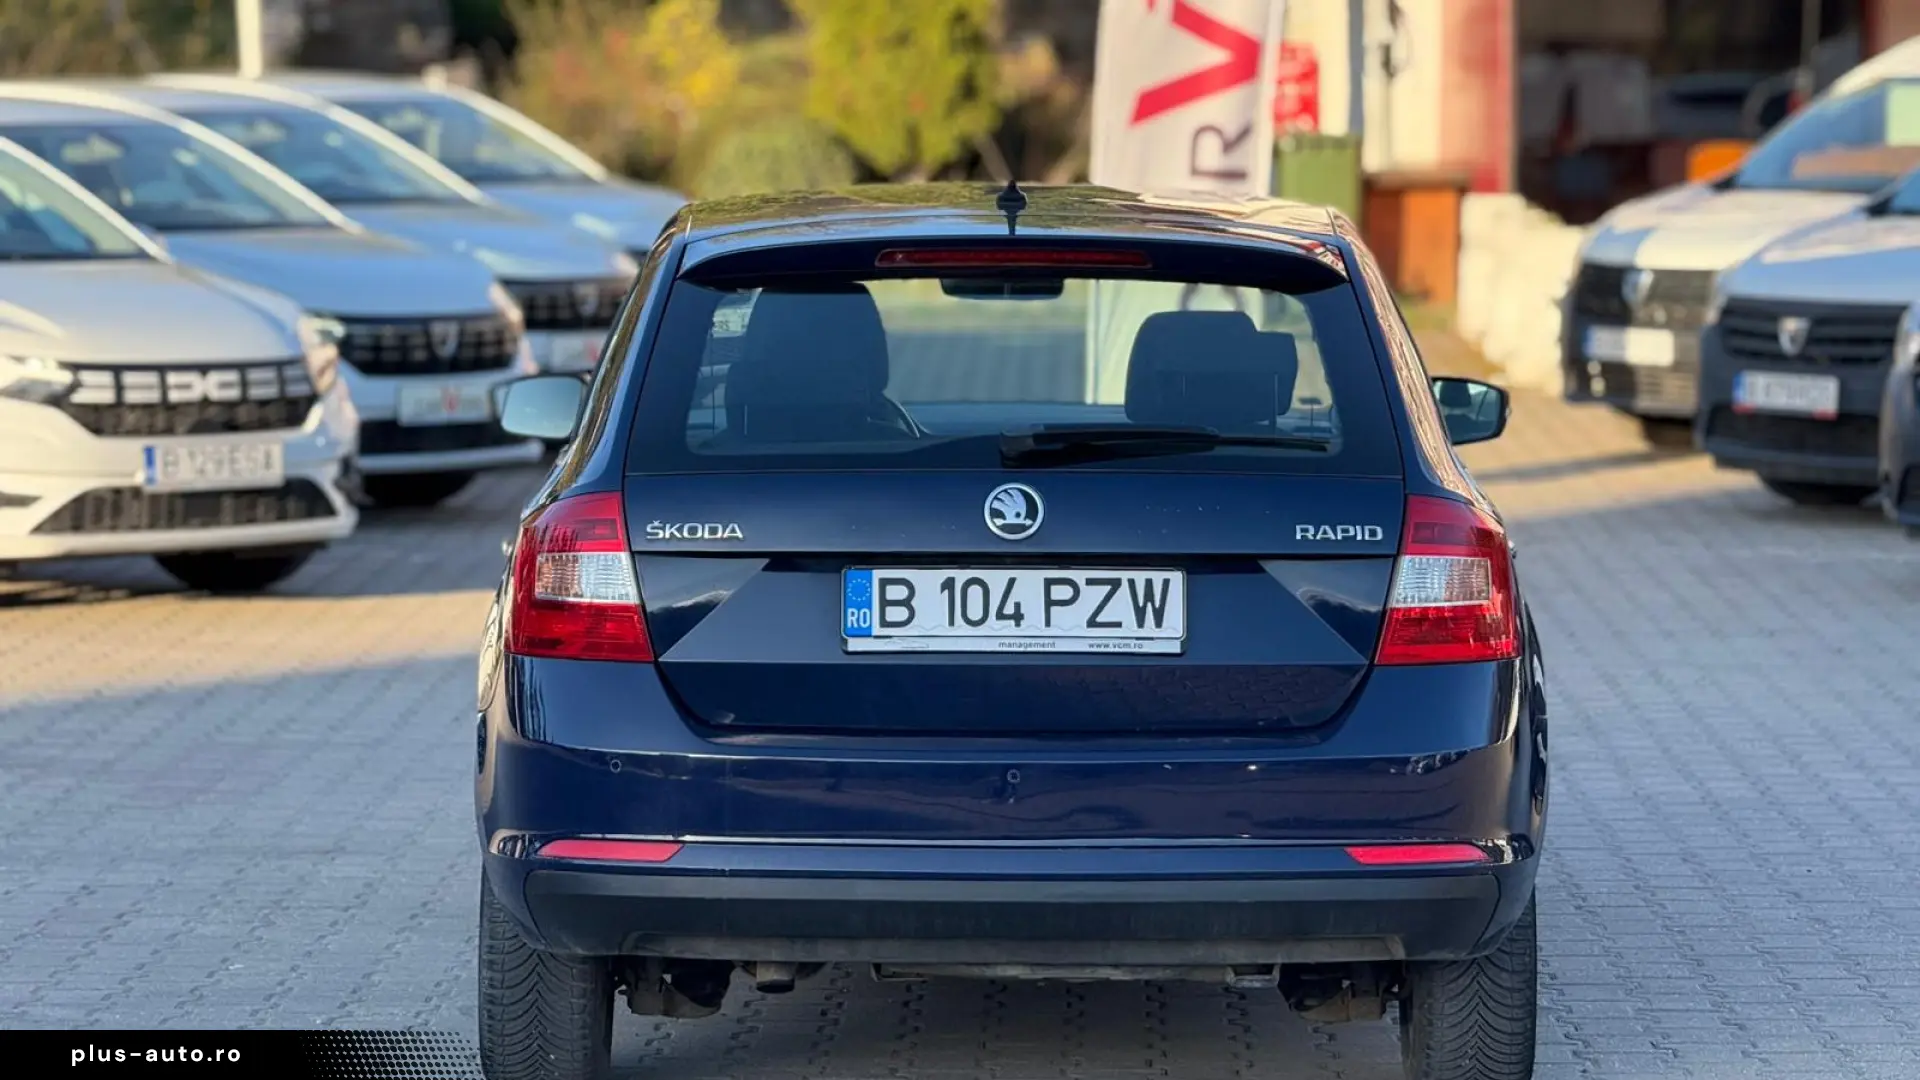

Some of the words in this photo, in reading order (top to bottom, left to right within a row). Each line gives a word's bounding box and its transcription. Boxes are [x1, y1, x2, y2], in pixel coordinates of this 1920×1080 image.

[645, 520, 744, 539] ŠKODA
[1295, 524, 1384, 541] RAPID
[878, 577, 915, 628] B
[940, 576, 1025, 628] 104
[1043, 577, 1170, 629] PZW
[847, 608, 870, 628] RO
[998, 640, 1056, 650] management
